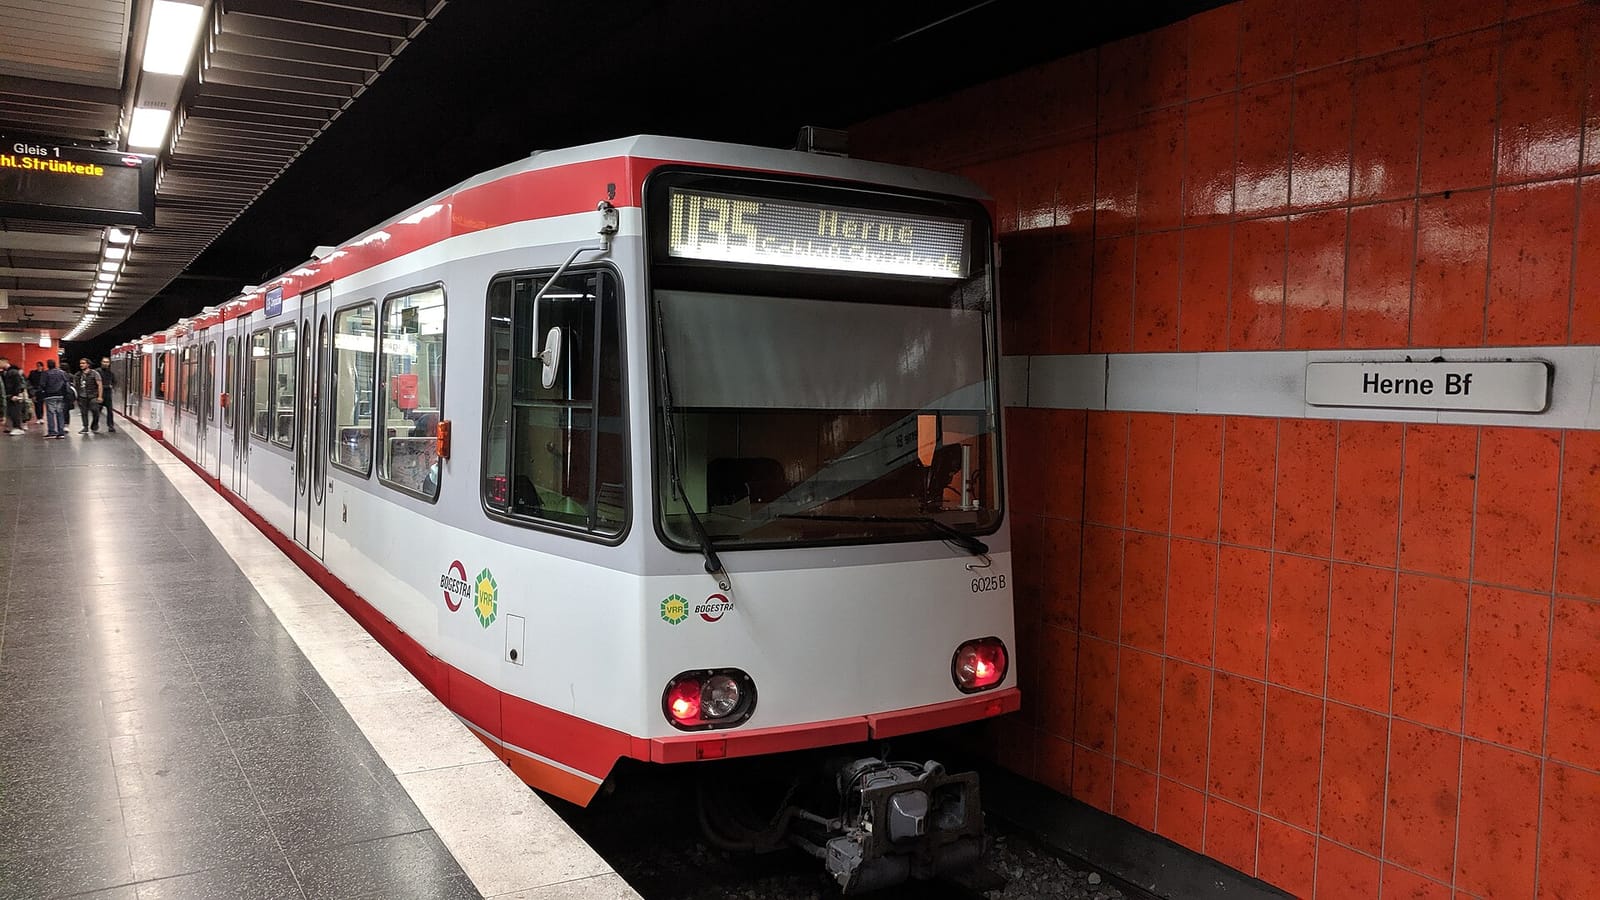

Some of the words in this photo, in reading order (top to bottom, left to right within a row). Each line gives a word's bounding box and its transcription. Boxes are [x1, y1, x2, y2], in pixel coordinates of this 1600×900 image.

[13, 143, 48, 156] Gleis
[52, 147, 60, 158] 1
[818, 209, 913, 244] Herne
[1362, 373, 1434, 394] Herne
[1445, 373, 1473, 395] Bf
[440, 574, 472, 599] BOGESTRA
[479, 590, 493, 607] VRR
[666, 605, 684, 614] VRR
[694, 603, 734, 613] BOGESTRA
